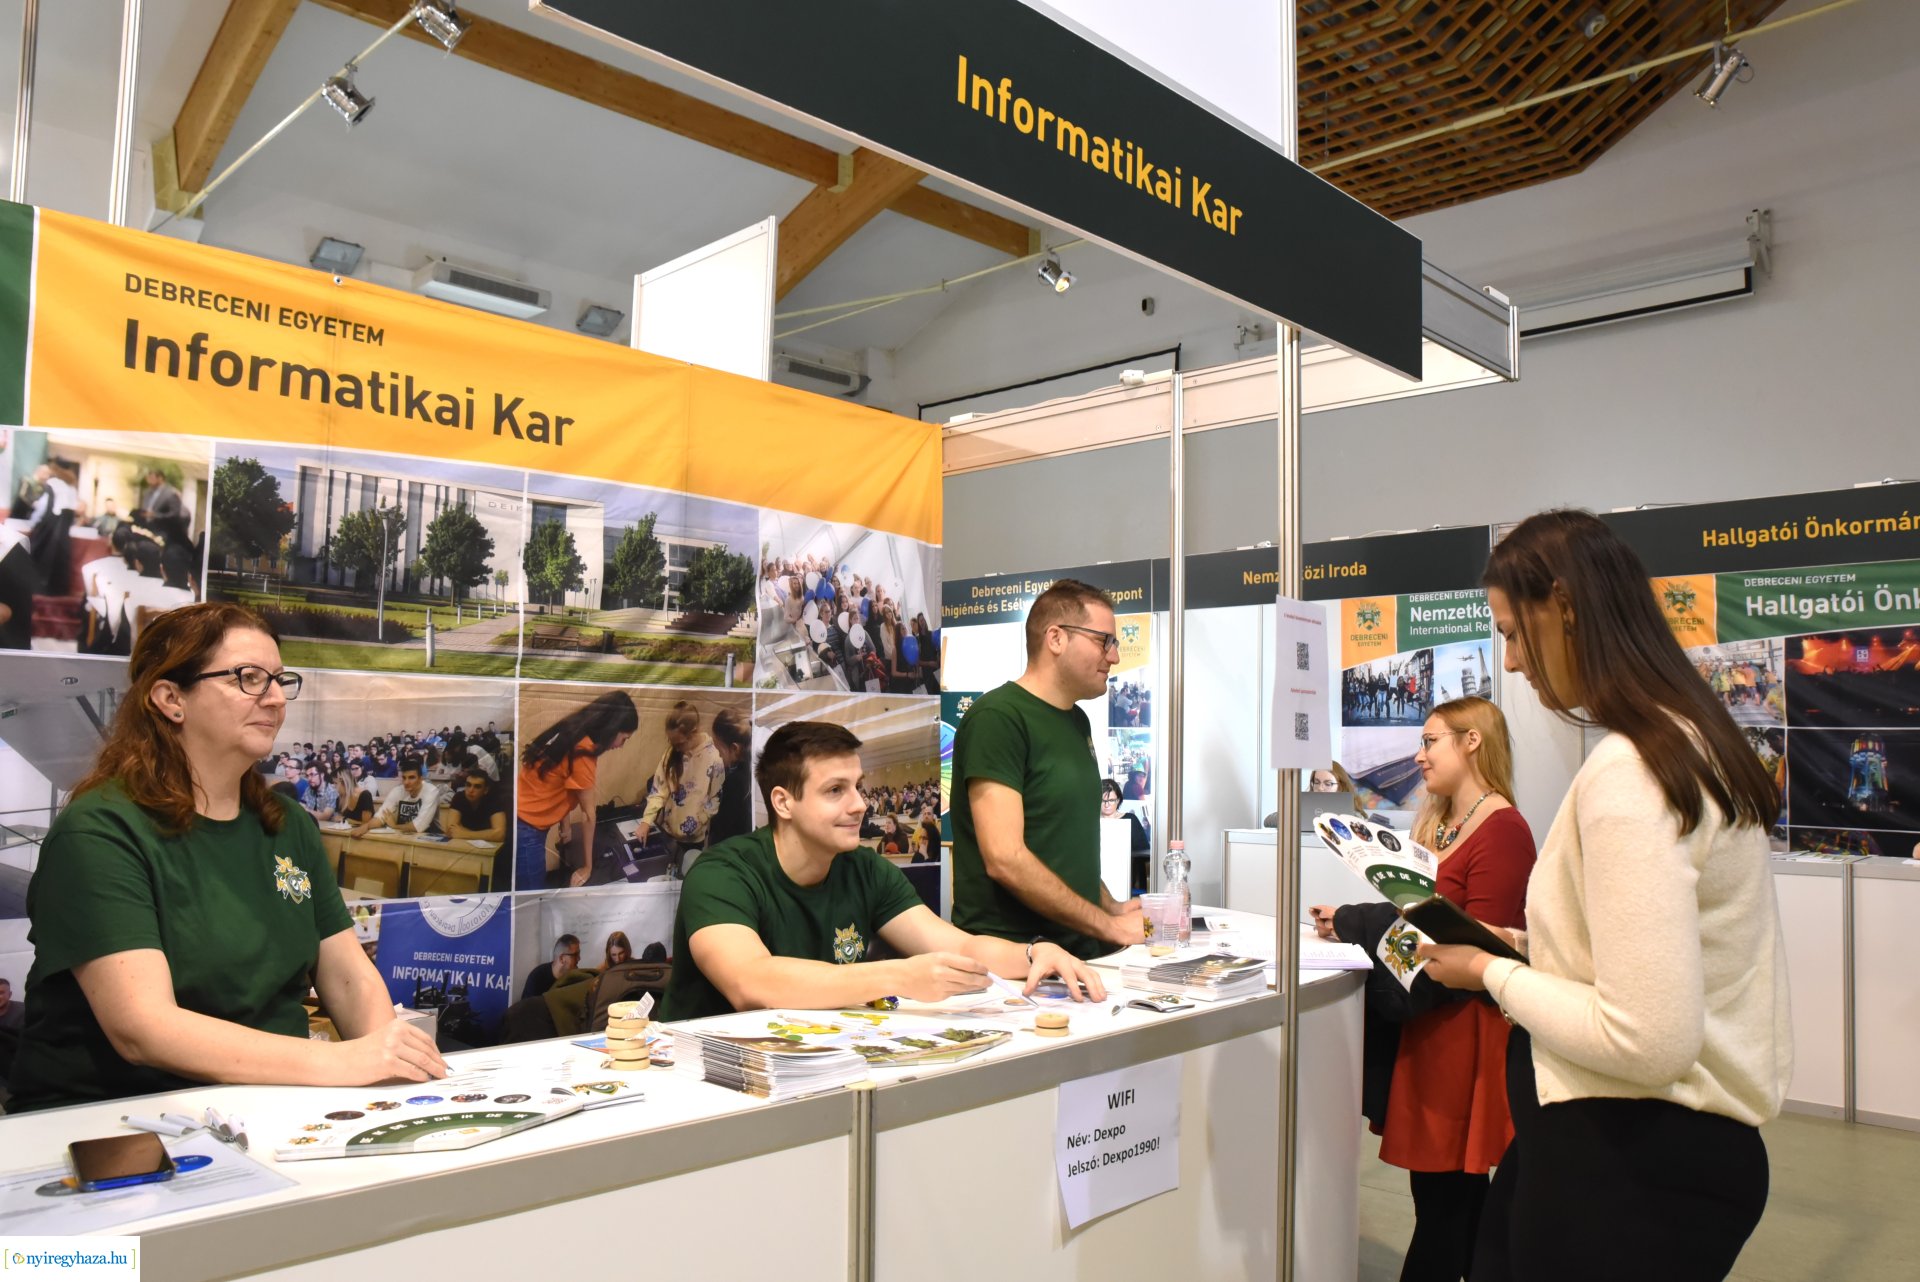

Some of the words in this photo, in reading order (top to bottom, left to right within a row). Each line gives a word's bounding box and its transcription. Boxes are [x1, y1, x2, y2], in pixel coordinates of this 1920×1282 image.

[957, 54, 1182, 209] Informatikai
[1191, 175, 1243, 236] Kar
[125, 272, 270, 323] DEBRECENI
[278, 307, 385, 347] EGYETEM
[124, 318, 475, 431] Informatikai
[492, 393, 575, 446] Kar
[1702, 521, 1798, 548] Hallgatói
[1243, 564, 1325, 586] Nemzözi
[1328, 561, 1367, 579] Iroda
[1744, 577, 1802, 587] DEBRECENI
[1805, 574, 1856, 584] EGYETEM
[972, 581, 1022, 599] Debreceni
[1409, 593, 1453, 603] DEBRECENI
[987, 600, 999, 613] és
[1746, 590, 1865, 619] Hallgatói
[1409, 622, 1472, 636] International
[413, 951, 452, 963] DEBRECENI
[453, 954, 495, 965] EGYETEM
[1107, 1088, 1135, 1110] WIFI
[1066, 1132, 1091, 1150] Név:
[1093, 1124, 1126, 1142] Dexpo
[1067, 1155, 1100, 1178] Jelszó:
[1102, 1136, 1161, 1166] Dexpo1990!
